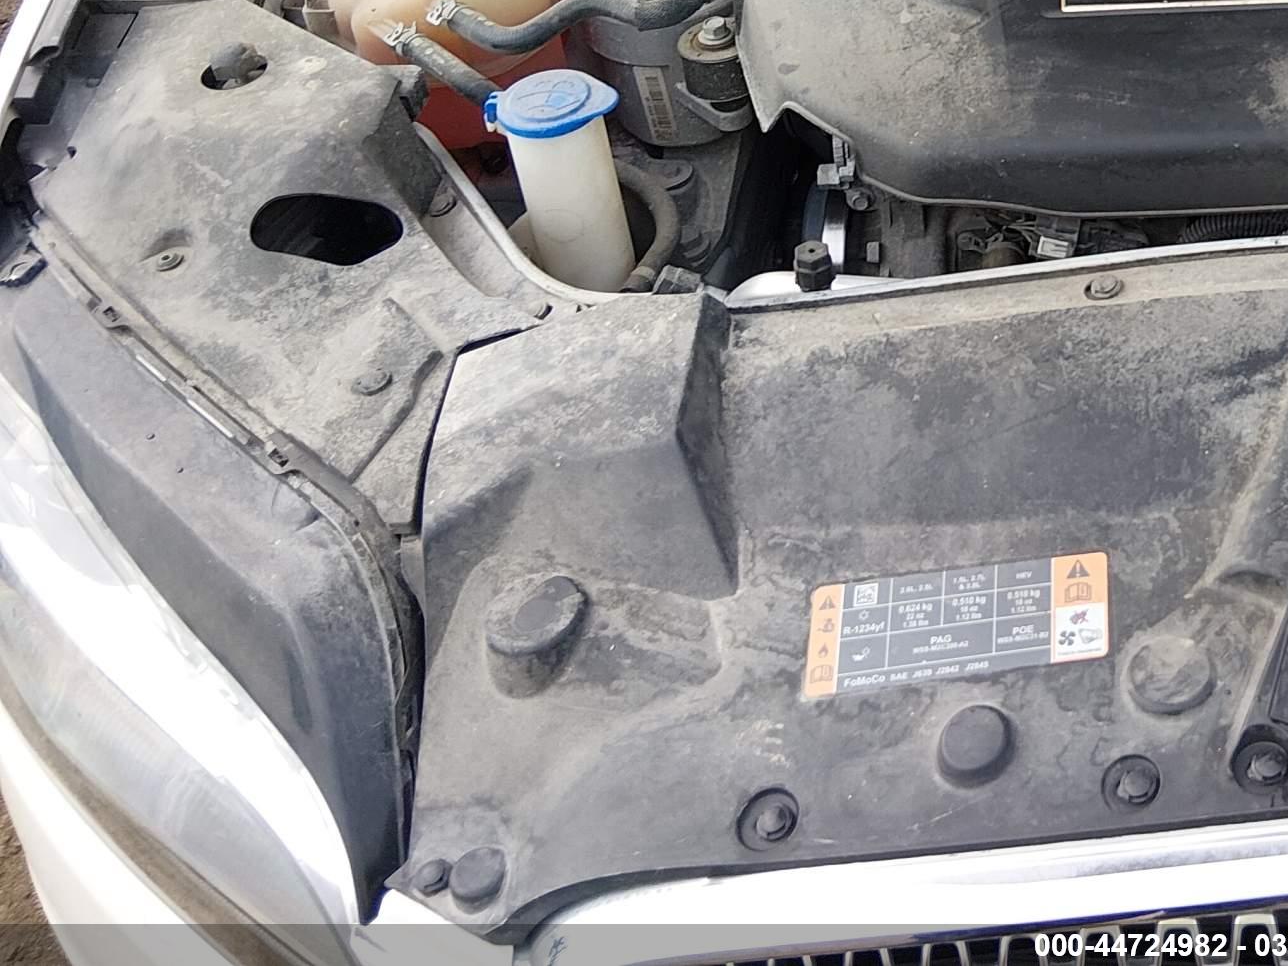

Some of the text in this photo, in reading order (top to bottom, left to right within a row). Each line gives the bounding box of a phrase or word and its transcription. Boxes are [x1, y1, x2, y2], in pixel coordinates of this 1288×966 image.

[975, 595, 987, 605] kg
[922, 602, 933, 612] kg
[842, 621, 885, 634] R-1234yf
[1012, 624, 1035, 635] POE
[930, 634, 952, 644] PAG
[843, 674, 886, 687] FoMoCo
